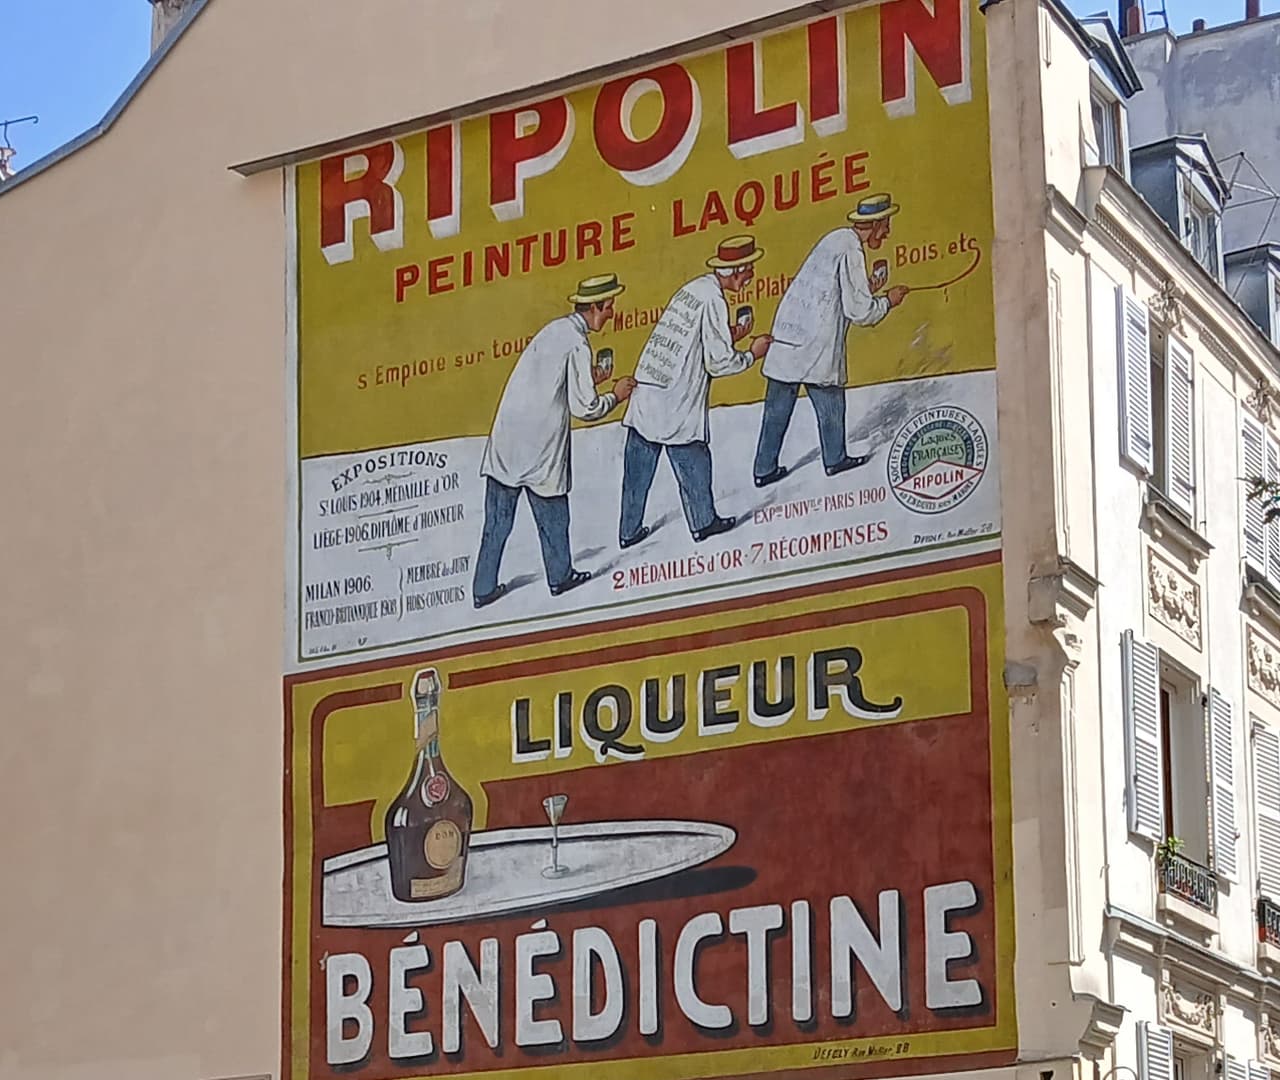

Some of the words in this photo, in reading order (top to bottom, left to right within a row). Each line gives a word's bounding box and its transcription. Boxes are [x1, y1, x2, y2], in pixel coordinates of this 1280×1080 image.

[320, 0, 971, 266] RIPOLIN
[395, 212, 636, 302] PEINTURE
[672, 151, 872, 238] LAQUÉE
[376, 356, 446, 387] Emploie
[454, 351, 485, 368] sur
[331, 450, 448, 493] EXPOSITIONS
[913, 469, 964, 490] RIPOLIN
[331, 494, 357, 515] LOUIS
[824, 490, 855, 513] PARIS
[859, 486, 886, 506] 1900
[769, 520, 888, 561] RÉCOMPENSES
[452, 555, 471, 573] JURY
[305, 580, 341, 603] MILAN
[511, 646, 903, 763] LIQUEUR
[326, 880, 984, 1067] BÉNÉDICTINE
